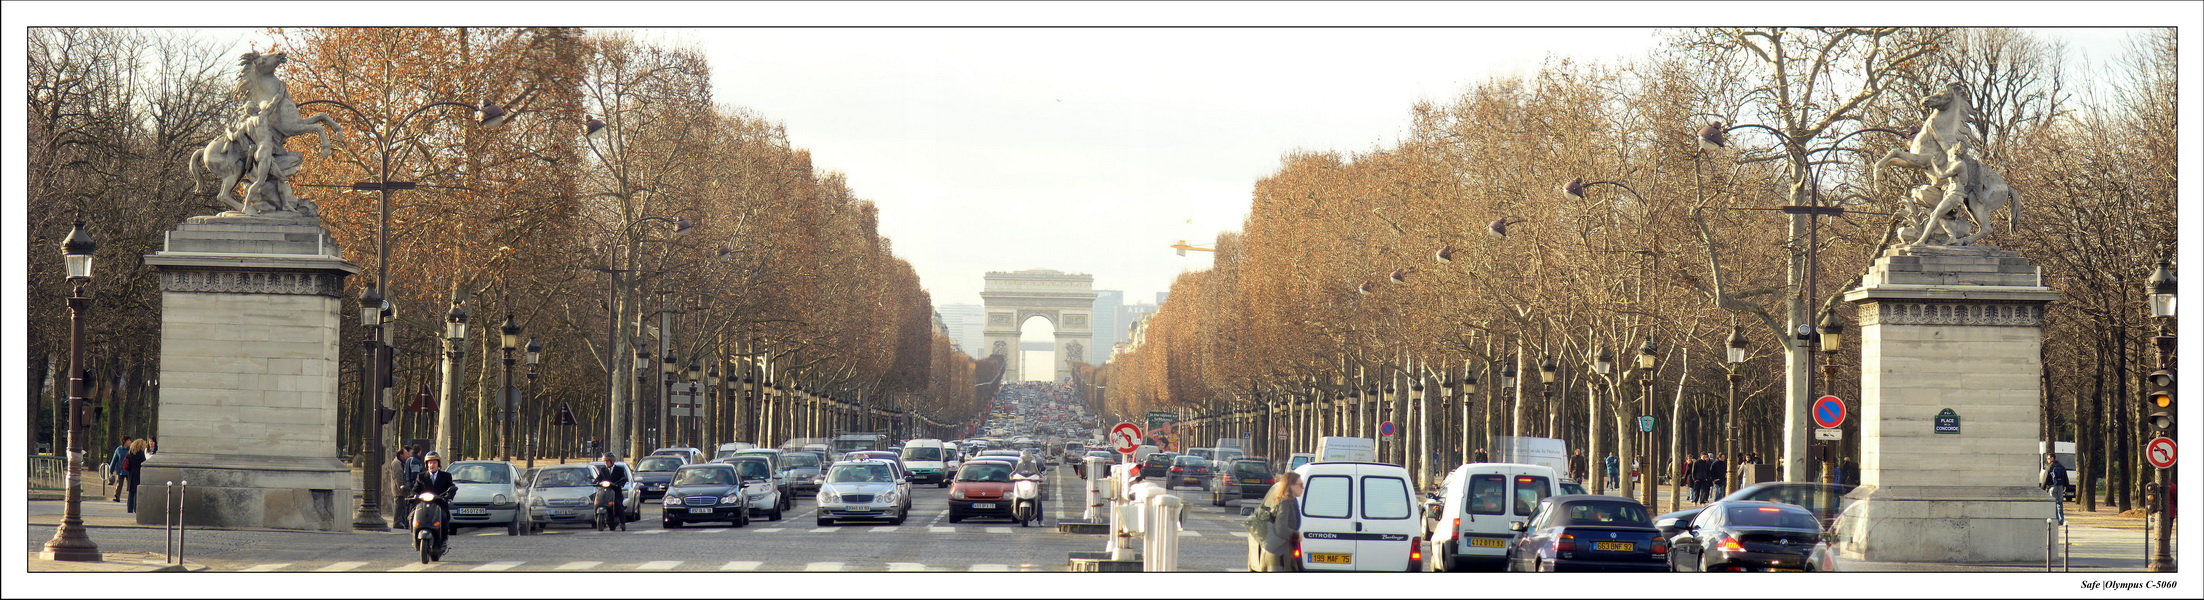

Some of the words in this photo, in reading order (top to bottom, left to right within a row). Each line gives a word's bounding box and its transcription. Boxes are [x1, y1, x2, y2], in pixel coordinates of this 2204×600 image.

[1597, 542, 1610, 550] 663
[1610, 542, 1622, 551] BNF
[1623, 543, 1633, 551] 92
[1313, 554, 1325, 562] 199
[1327, 554, 1339, 562] MAF
[1342, 555, 1350, 563] 75
